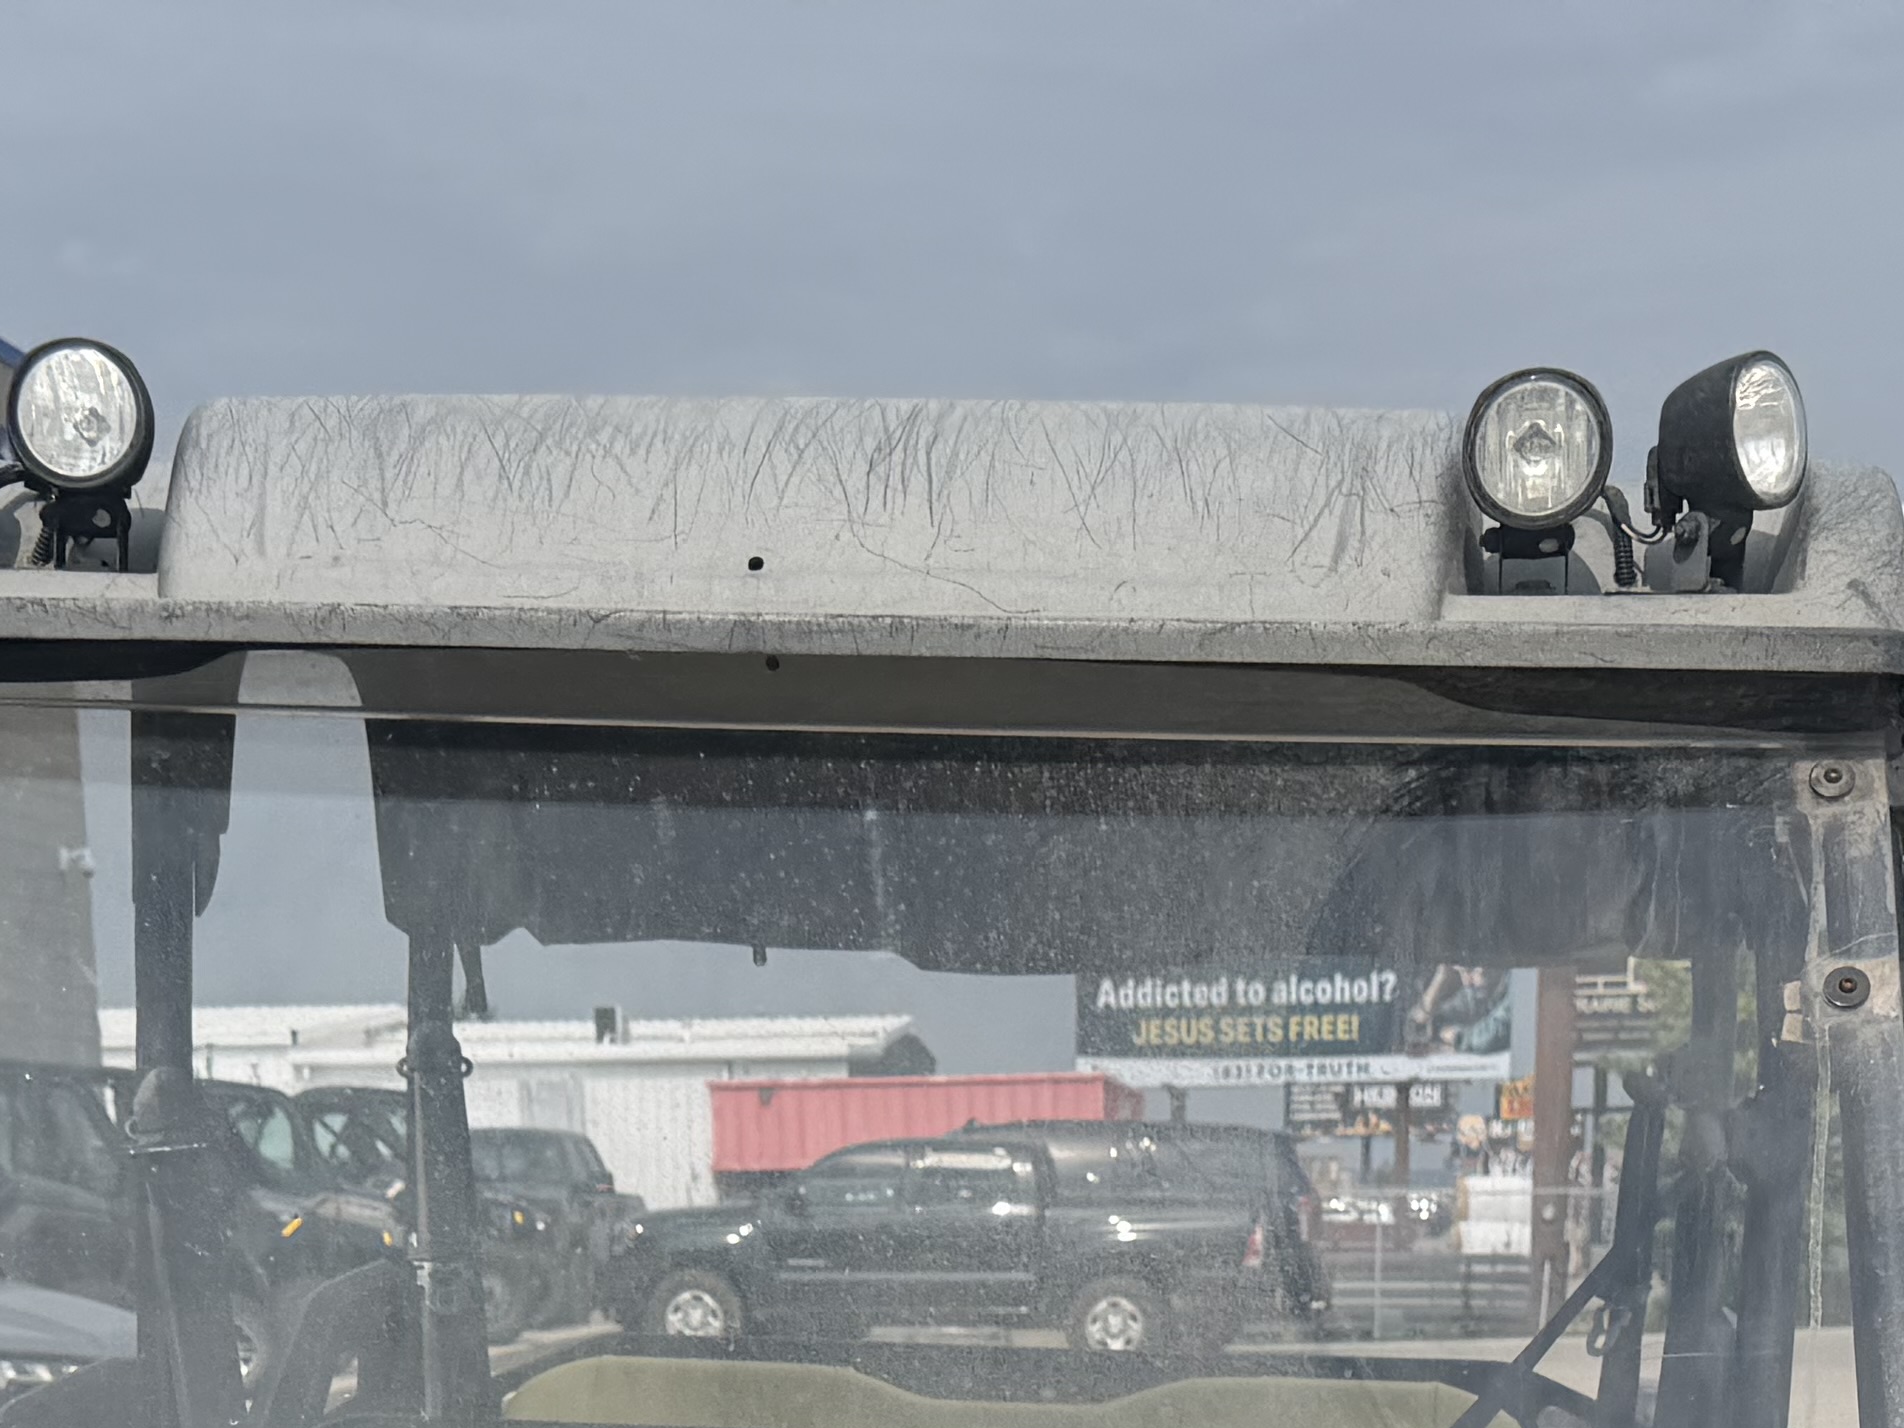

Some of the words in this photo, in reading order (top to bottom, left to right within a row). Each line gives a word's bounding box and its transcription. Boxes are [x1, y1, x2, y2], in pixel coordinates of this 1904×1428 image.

[1097, 976, 1229, 1010] Addicted
[1235, 976, 1265, 1007] to
[1271, 970, 1398, 1007] alcohol?
[1133, 1017, 1215, 1047] JESUS
[1219, 1016, 1284, 1044] SETS
[1289, 1014, 1360, 1042] FREE!
